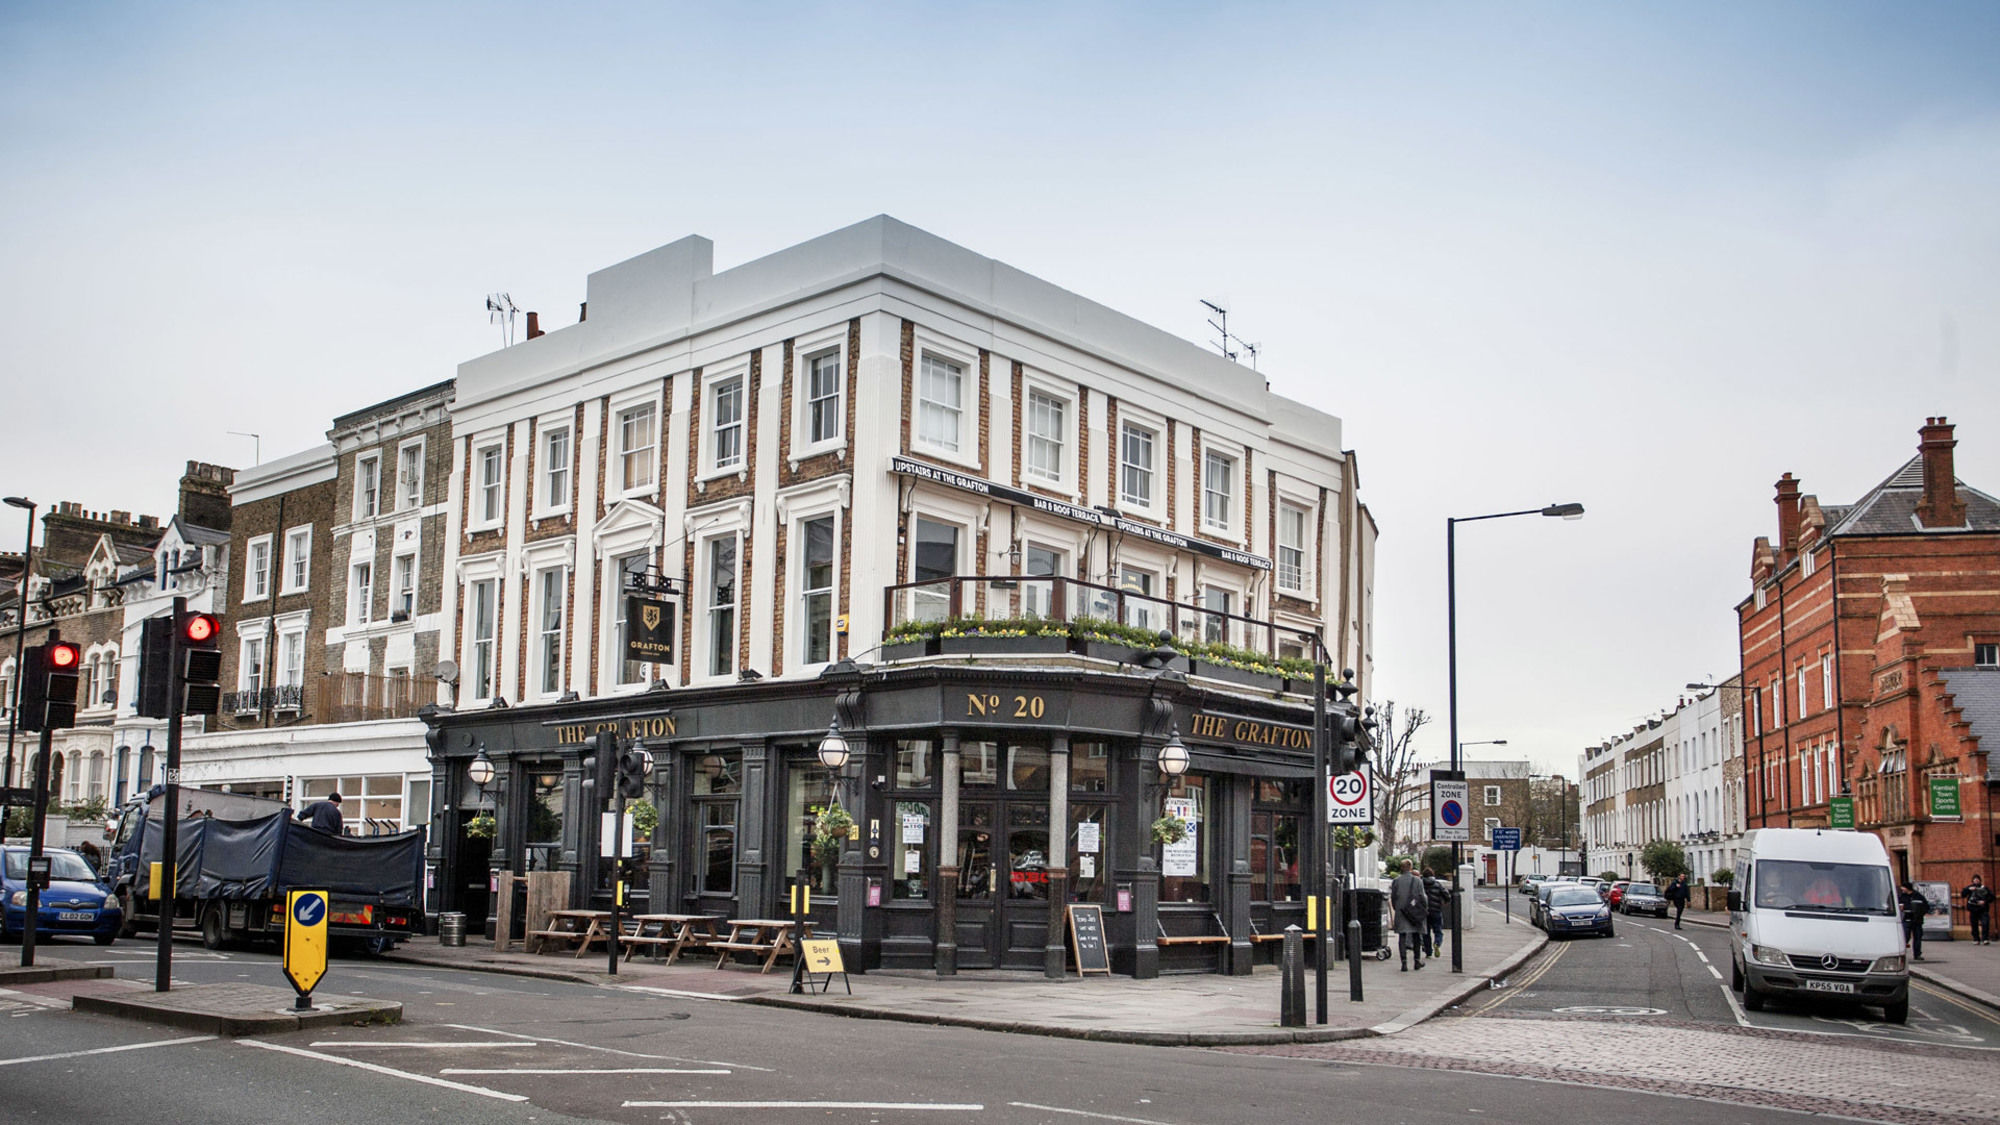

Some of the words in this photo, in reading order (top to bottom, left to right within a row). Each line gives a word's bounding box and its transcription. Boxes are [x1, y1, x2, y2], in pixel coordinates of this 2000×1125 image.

[895, 461, 931, 478] UPSTAIRS
[933, 471, 941, 480] AT
[943, 473, 956, 485] THE
[957, 476, 989, 494] GRAFTON
[1034, 498, 1047, 509] BAR
[1053, 504, 1070, 516] ROOF
[1072, 508, 1099, 523] TERRACE
[1118, 521, 1144, 536] UPSTAIRS
[1145, 530, 1151, 538] AT
[1152, 530, 1162, 540] THE
[1162, 534, 1188, 548] GRAFTON
[1221, 550, 1231, 560] BAR
[1236, 554, 1249, 564] ROOF
[630, 641, 670, 652] GRAFTON
[1013, 695, 1044, 719] 20
[555, 725, 587, 744] THE
[1192, 713, 1227, 738] THE
[1235, 721, 1312, 749] GRAFTON
[1336, 778, 1362, 794] 20
[1441, 791, 1462, 799] ZONE
[1332, 807, 1366, 818] ZONE
[1809, 982, 1832, 991] KP55
[1834, 983, 1850, 993] VOA
